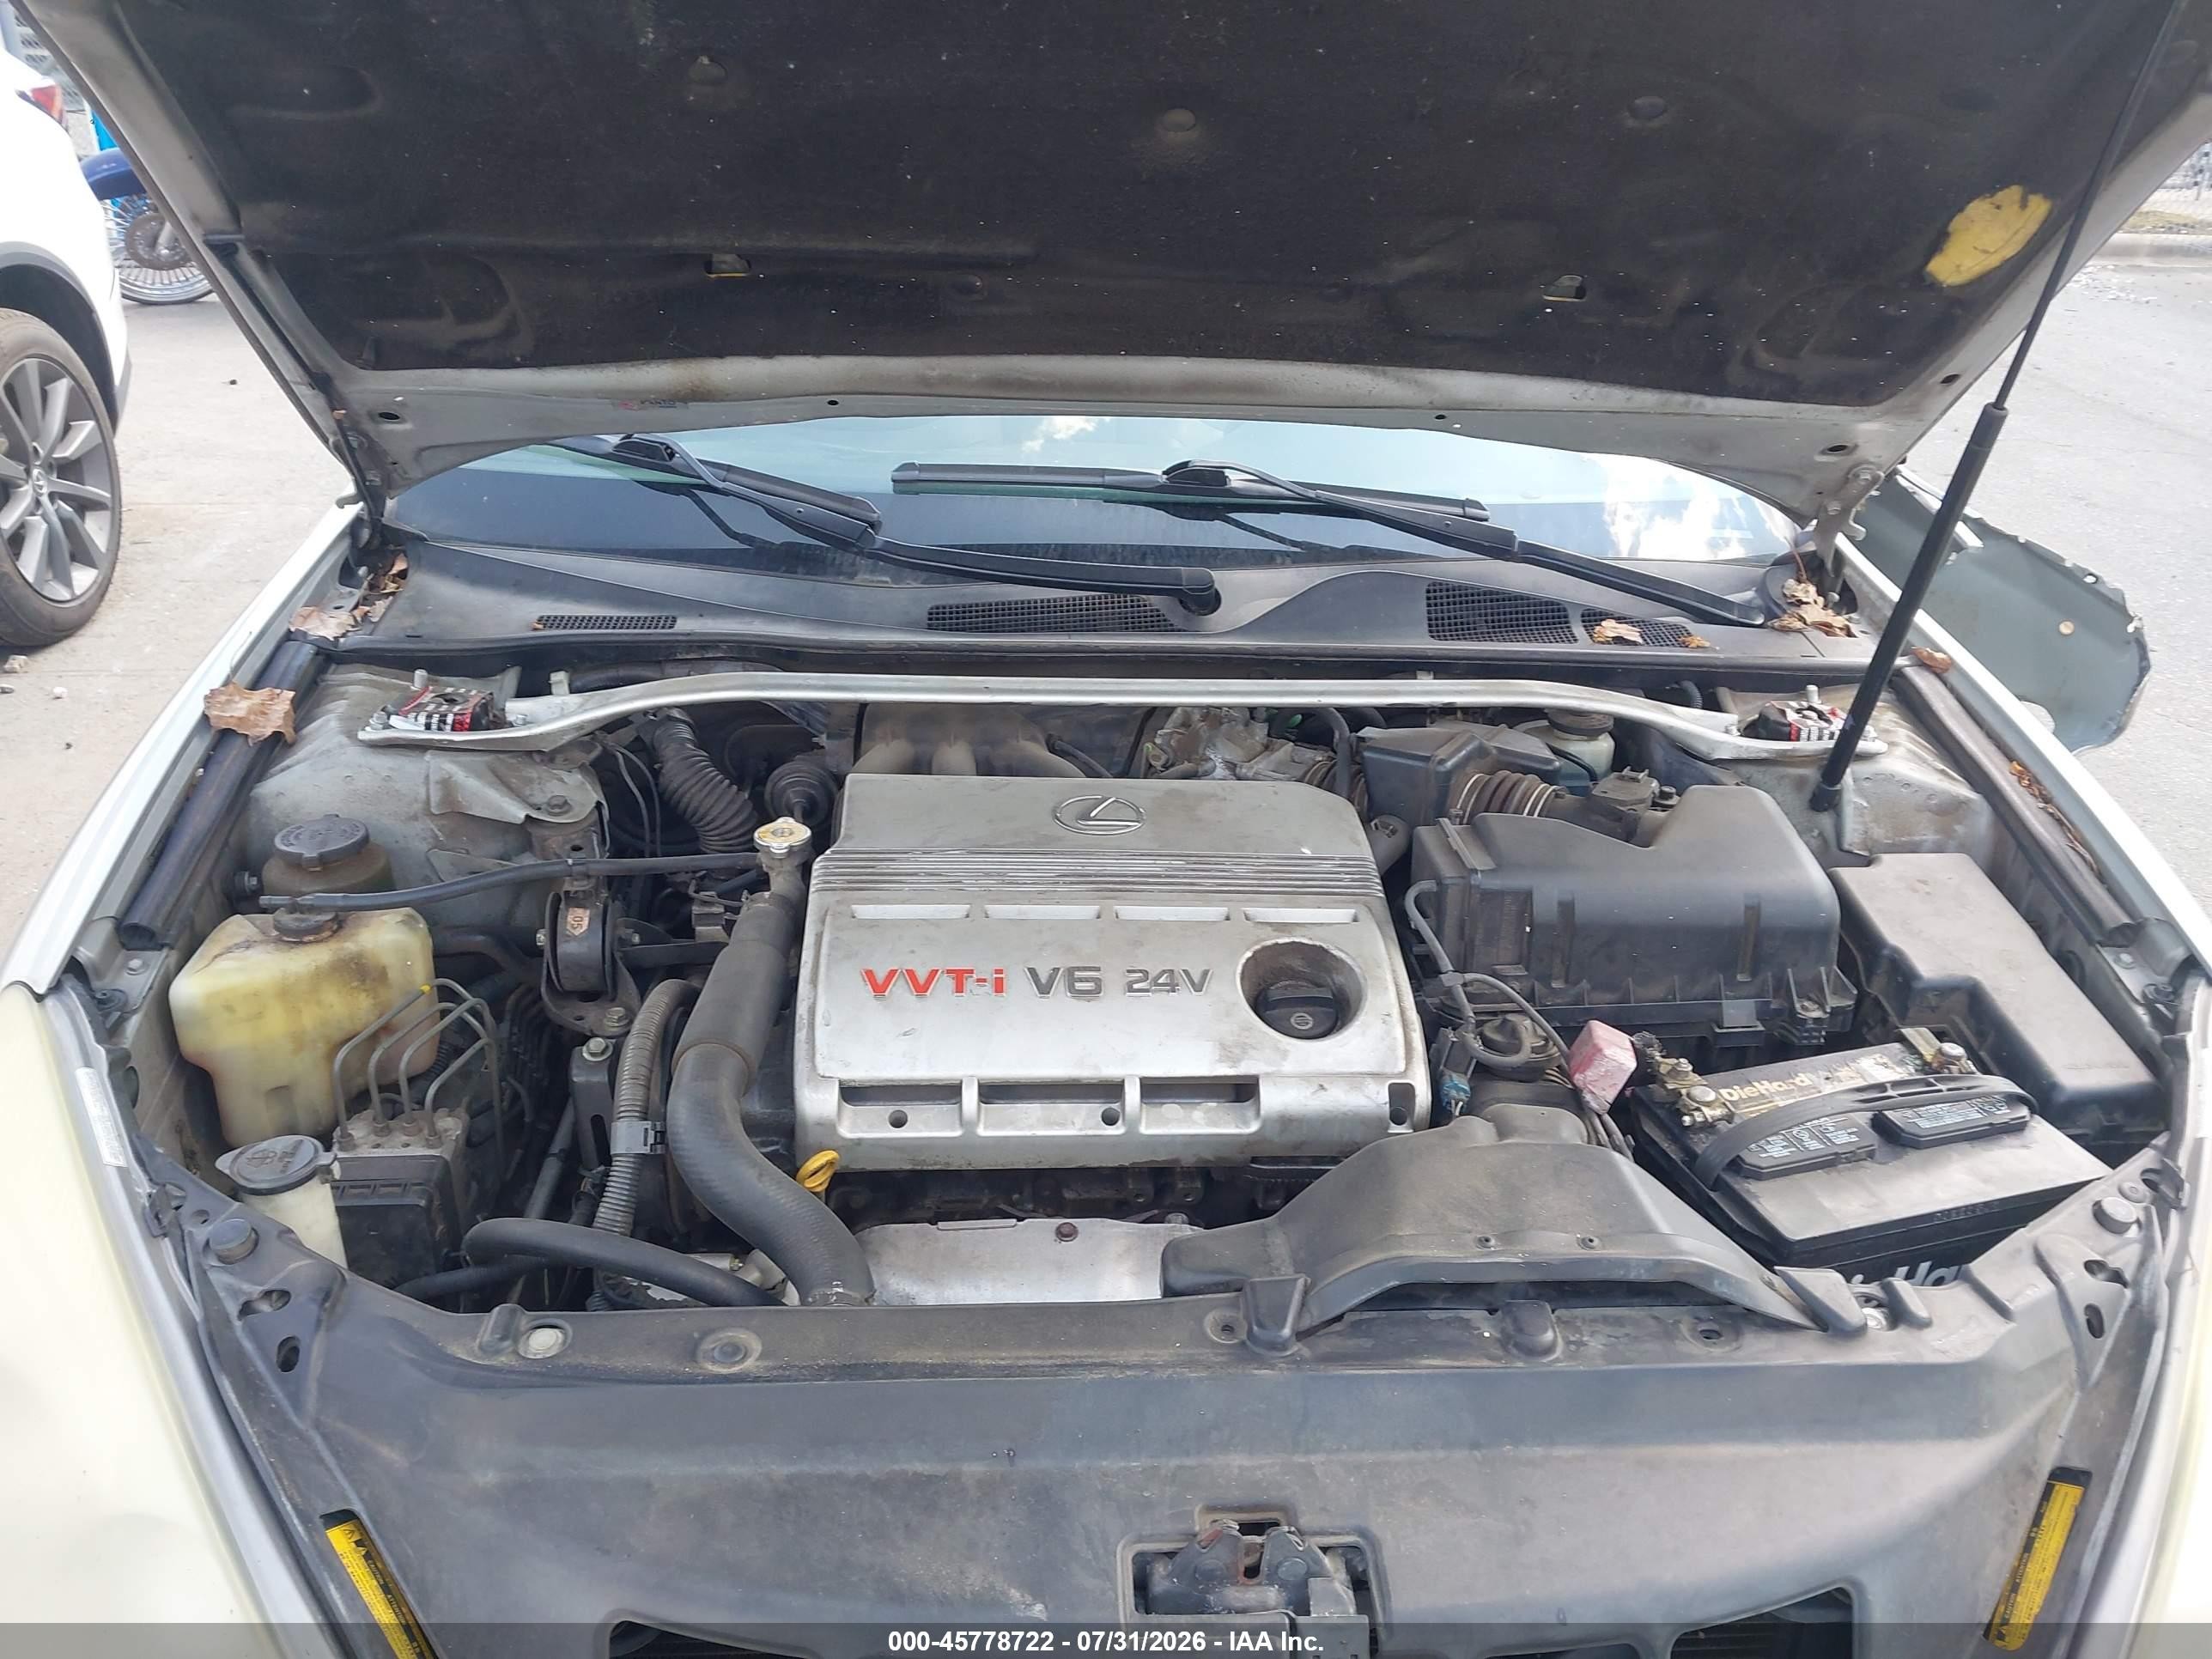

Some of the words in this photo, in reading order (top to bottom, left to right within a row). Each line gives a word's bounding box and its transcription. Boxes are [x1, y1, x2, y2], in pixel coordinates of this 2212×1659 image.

[861, 968, 1007, 998] VVT-i
[1024, 966, 1105, 998] V6
[1123, 968, 1212, 997] 24V
